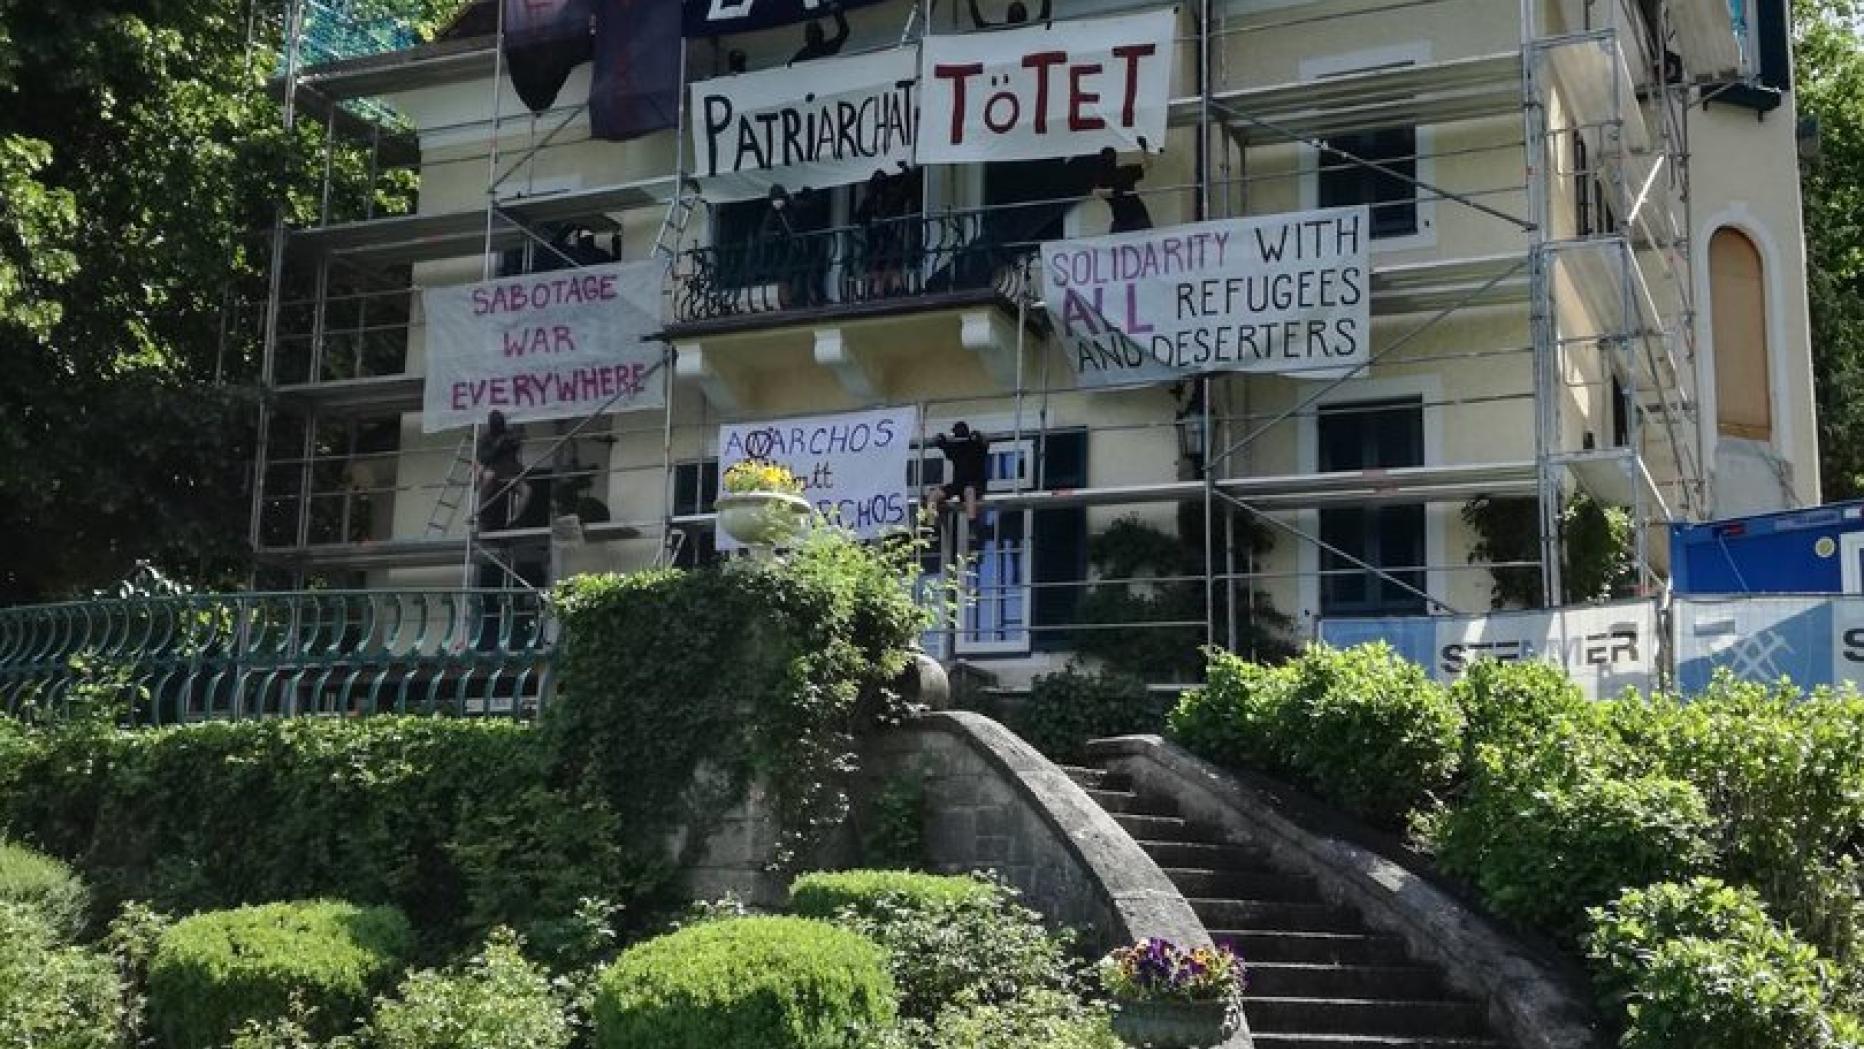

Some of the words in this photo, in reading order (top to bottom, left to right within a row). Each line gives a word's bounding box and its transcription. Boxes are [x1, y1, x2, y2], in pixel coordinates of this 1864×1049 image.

[1051, 231, 1230, 287] SOLIDARITY
[1256, 216, 1359, 263] WITH
[472, 274, 618, 316] SABOTAGE
[1062, 283, 1154, 337] ALL
[1177, 266, 1361, 320] REFUGEES
[503, 326, 576, 358] WAR
[1078, 334, 1142, 373] AND
[1153, 318, 1357, 368] DESERTERS
[452, 363, 645, 410] EVERYWHERE
